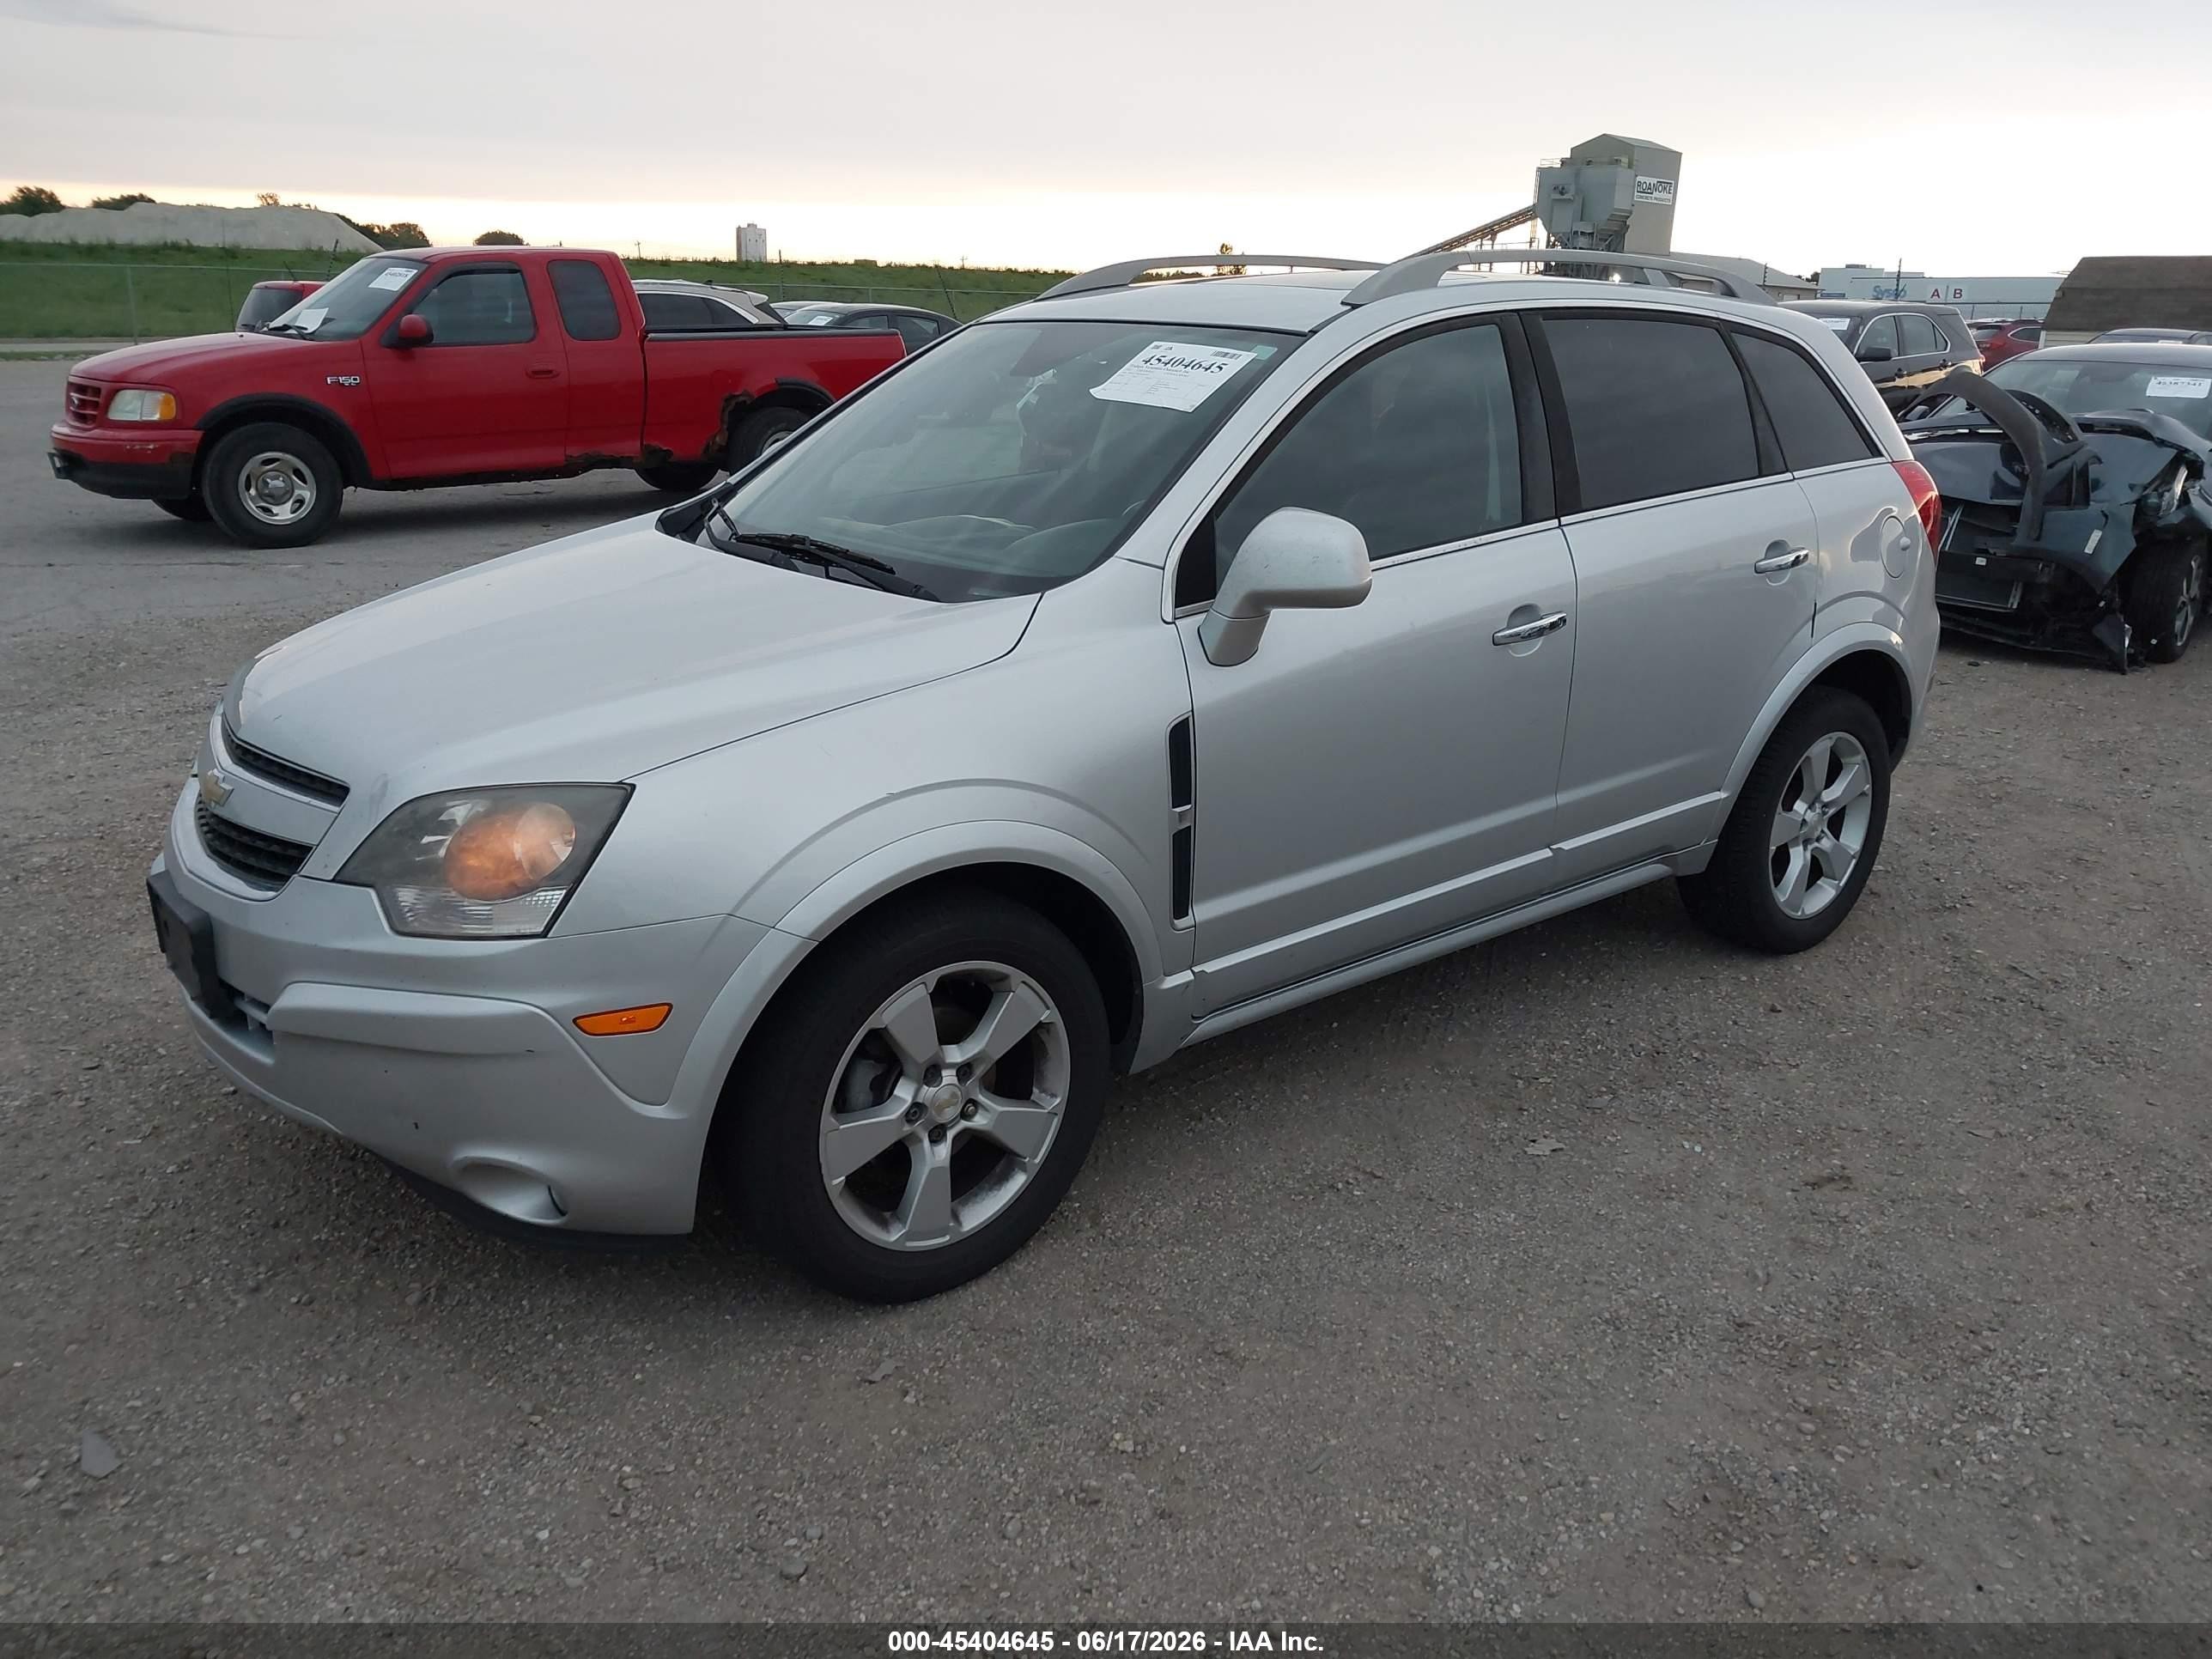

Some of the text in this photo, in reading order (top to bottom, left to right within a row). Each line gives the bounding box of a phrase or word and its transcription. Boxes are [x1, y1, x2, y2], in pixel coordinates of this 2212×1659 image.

[1636, 180, 1674, 195] ROANOKE
[1929, 288, 1964, 300] A B
[1142, 353, 1230, 374] 45404645
[326, 375, 361, 385] F150
